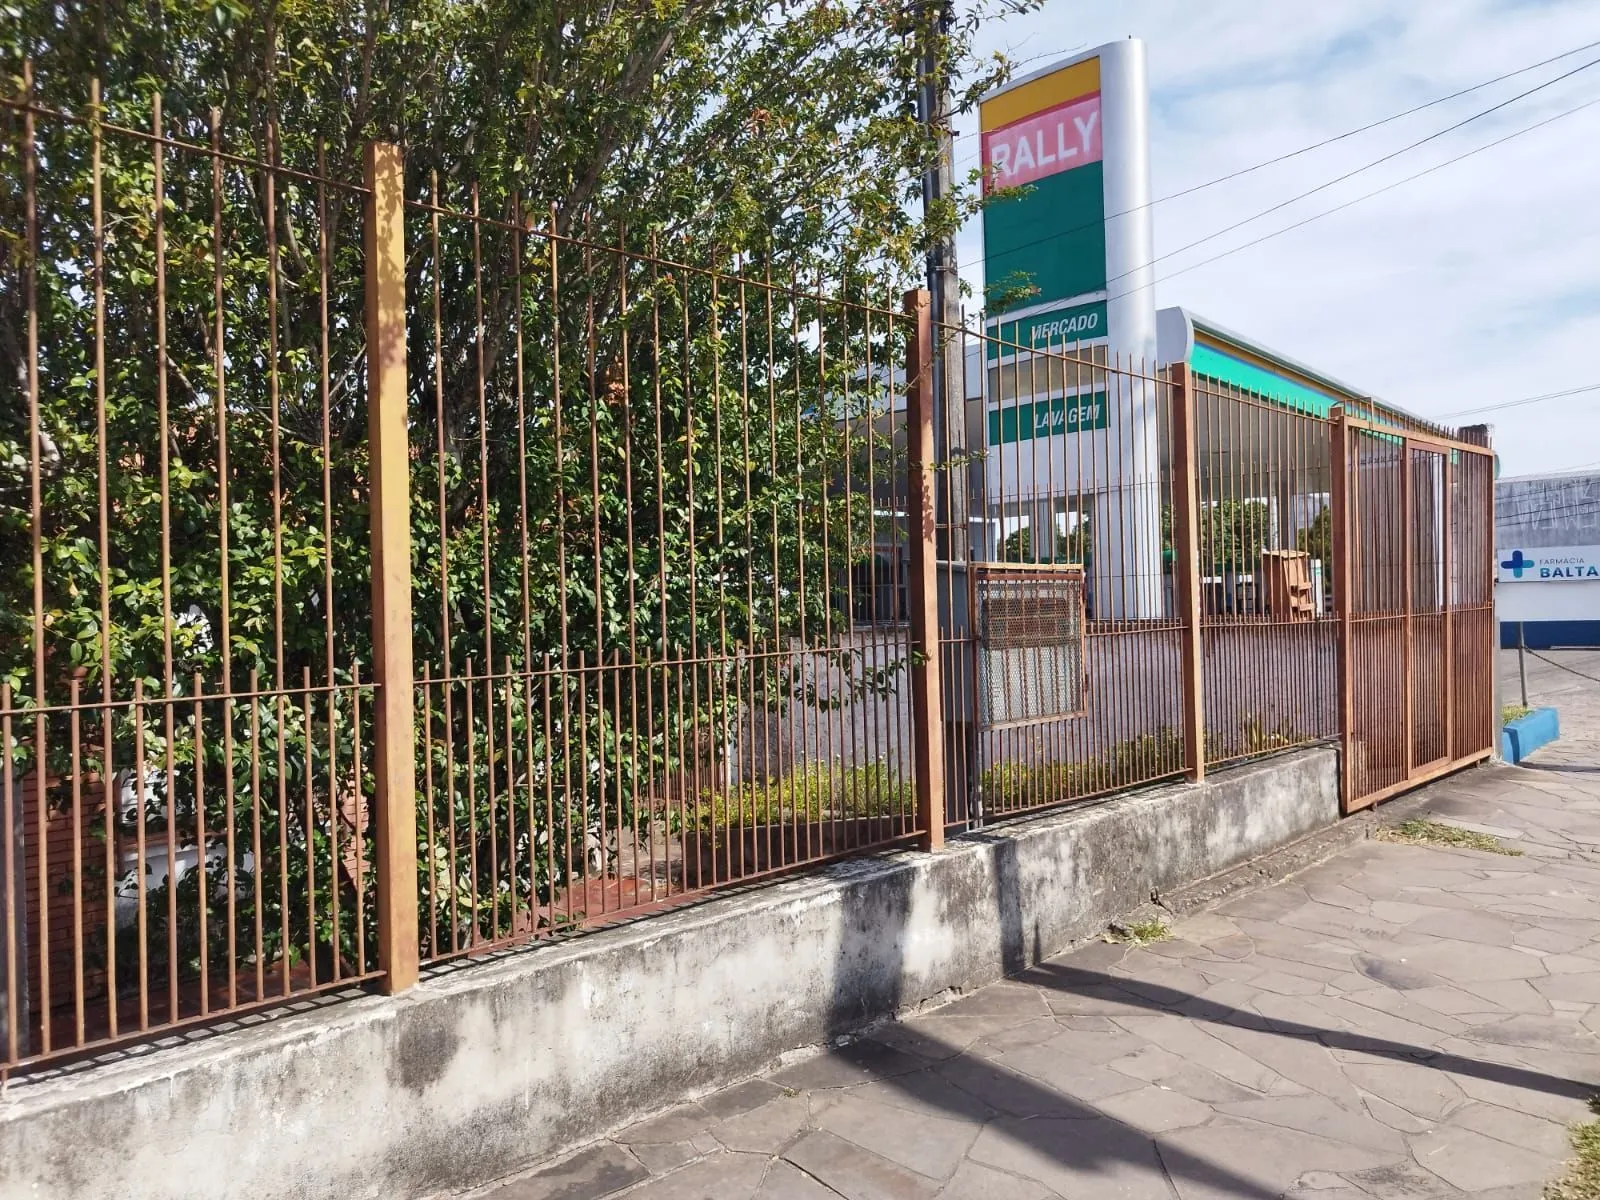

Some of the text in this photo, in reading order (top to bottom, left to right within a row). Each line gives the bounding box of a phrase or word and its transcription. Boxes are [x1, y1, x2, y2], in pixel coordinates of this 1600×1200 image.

[991, 111, 1098, 178] RALLY
[1032, 312, 1099, 340] MERCADO
[1540, 565, 1599, 579] BALTA
